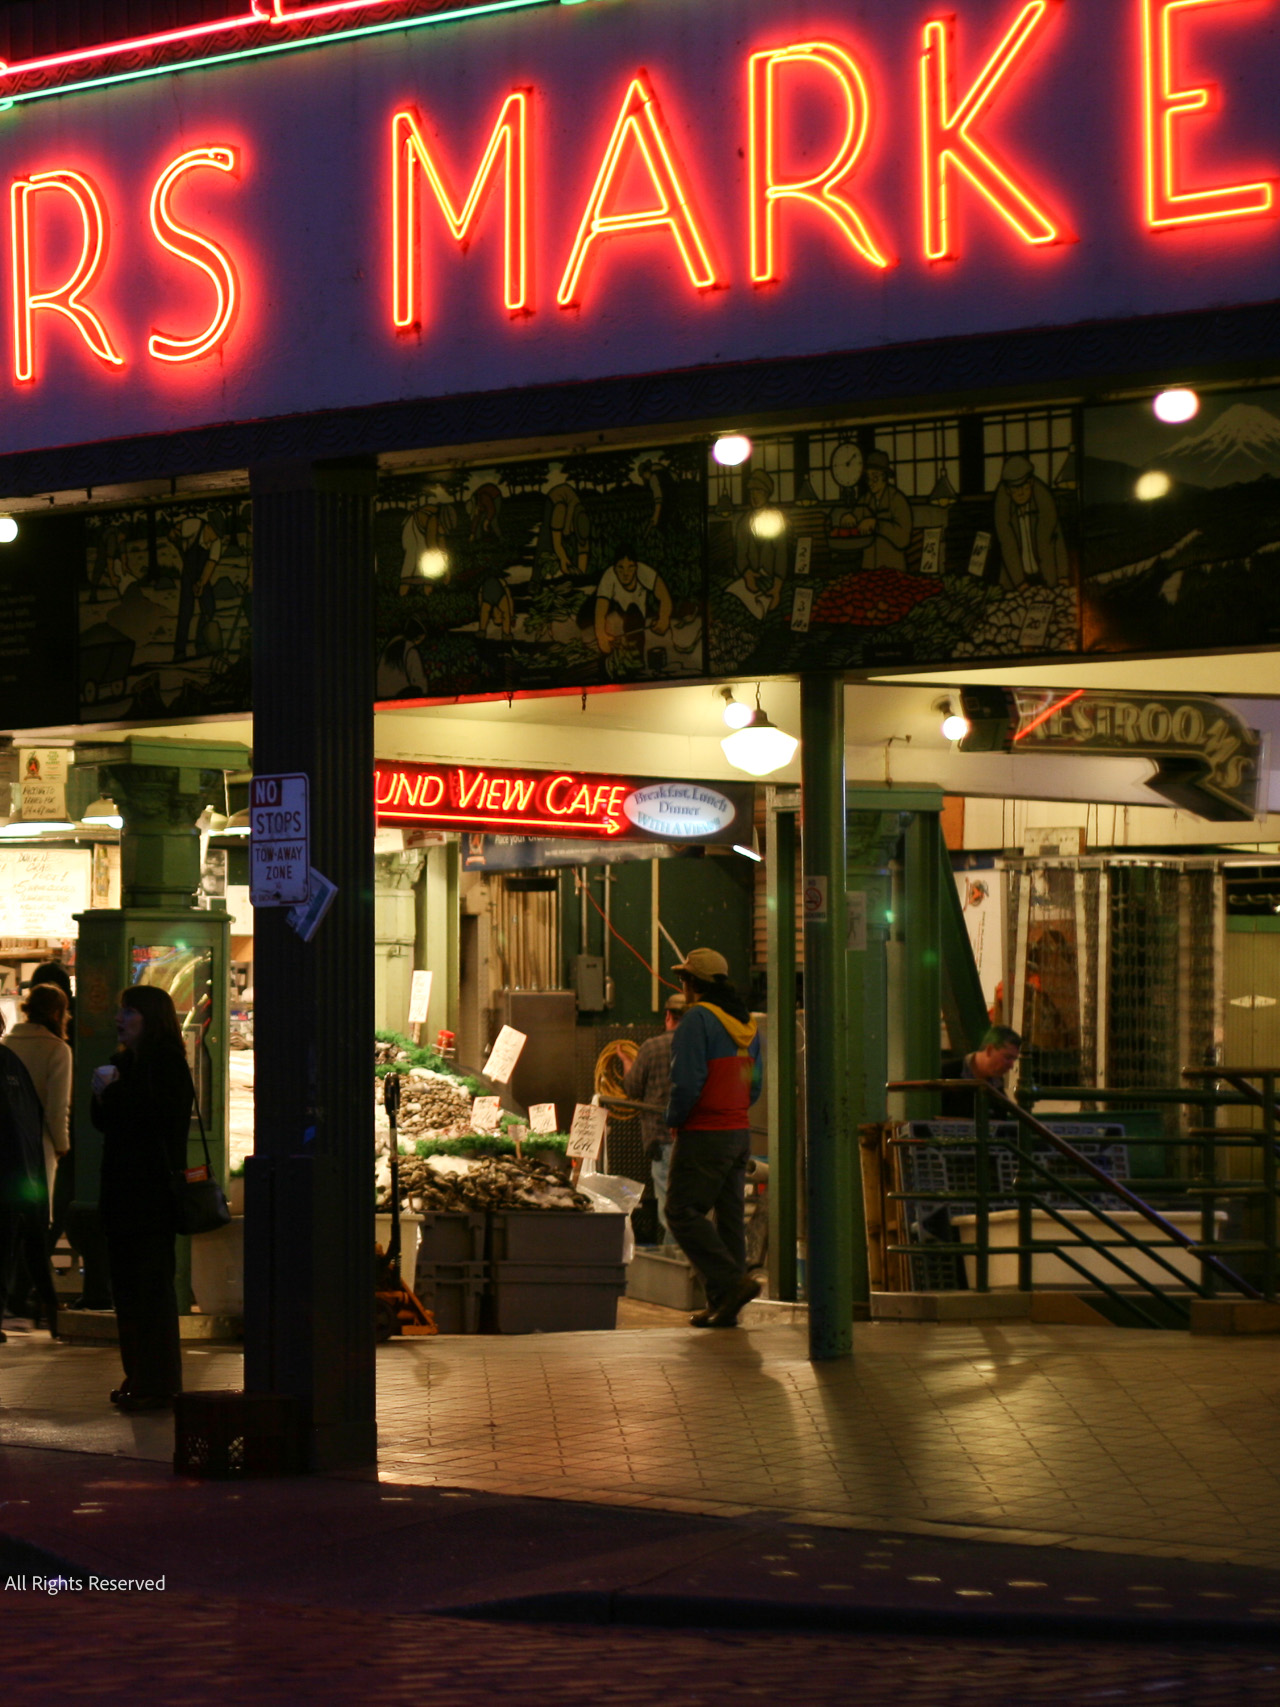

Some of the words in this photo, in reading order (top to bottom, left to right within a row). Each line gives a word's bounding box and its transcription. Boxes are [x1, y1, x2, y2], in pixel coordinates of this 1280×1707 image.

[392, 0, 1274, 327] MARKE
[1021, 697, 1257, 790] RESTROOMS
[255, 780, 278, 805] NO
[457, 769, 535, 811] VIEW
[546, 775, 626, 818] CAFE
[692, 787, 728, 813] Lunch
[658, 800, 702, 816] Dinner
[256, 810, 302, 835] STOPS
[255, 846, 303, 863] TOW-AWAY
[266, 865, 293, 881] ZONE
